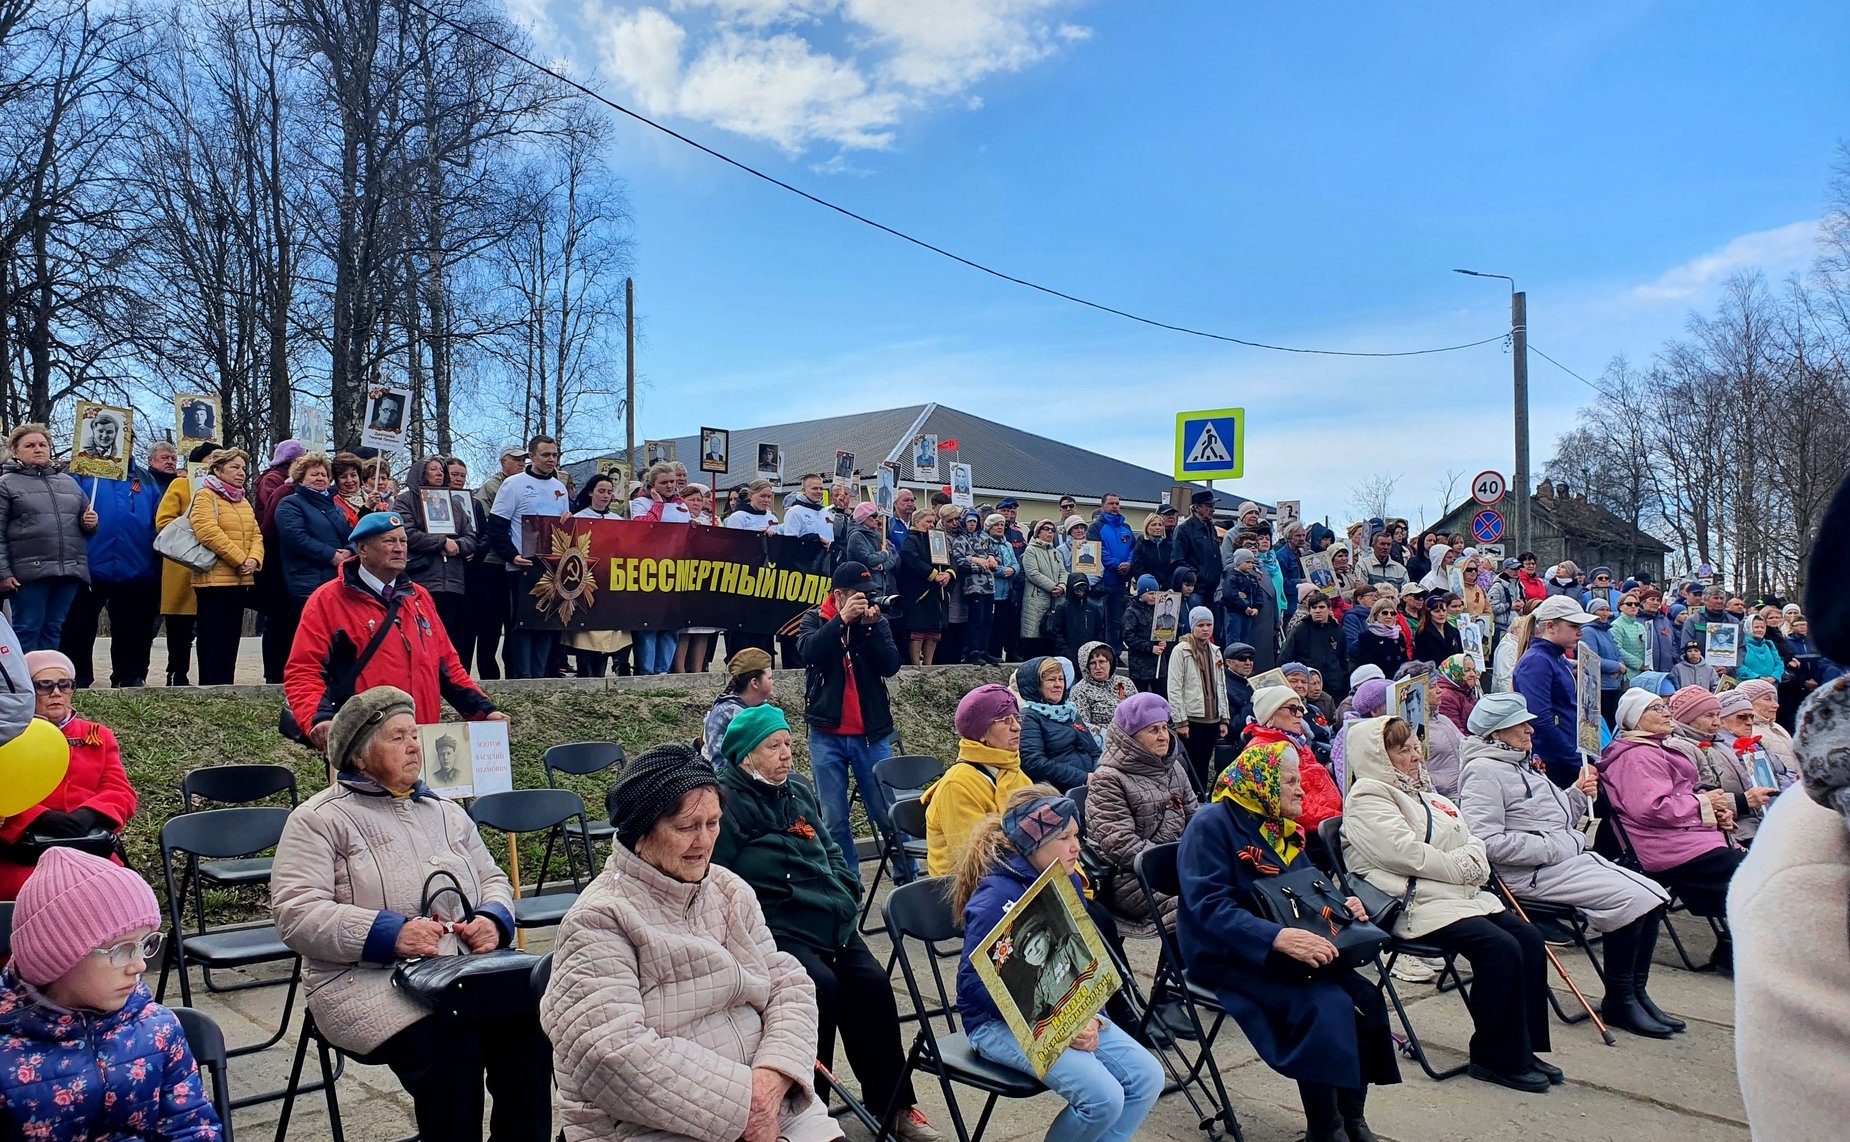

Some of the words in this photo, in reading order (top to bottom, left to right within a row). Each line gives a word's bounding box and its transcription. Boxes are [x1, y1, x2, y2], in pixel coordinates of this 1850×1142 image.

[1478, 480, 1498, 494] 40
[609, 557, 776, 599] БЕССМЕРТНЫЙ
[776, 570, 833, 605] ПОЛК
[1038, 1022, 1070, 1061] Василий
[1068, 972, 1112, 1025] Михайлович
[1051, 985, 1088, 1030] Нечаев
